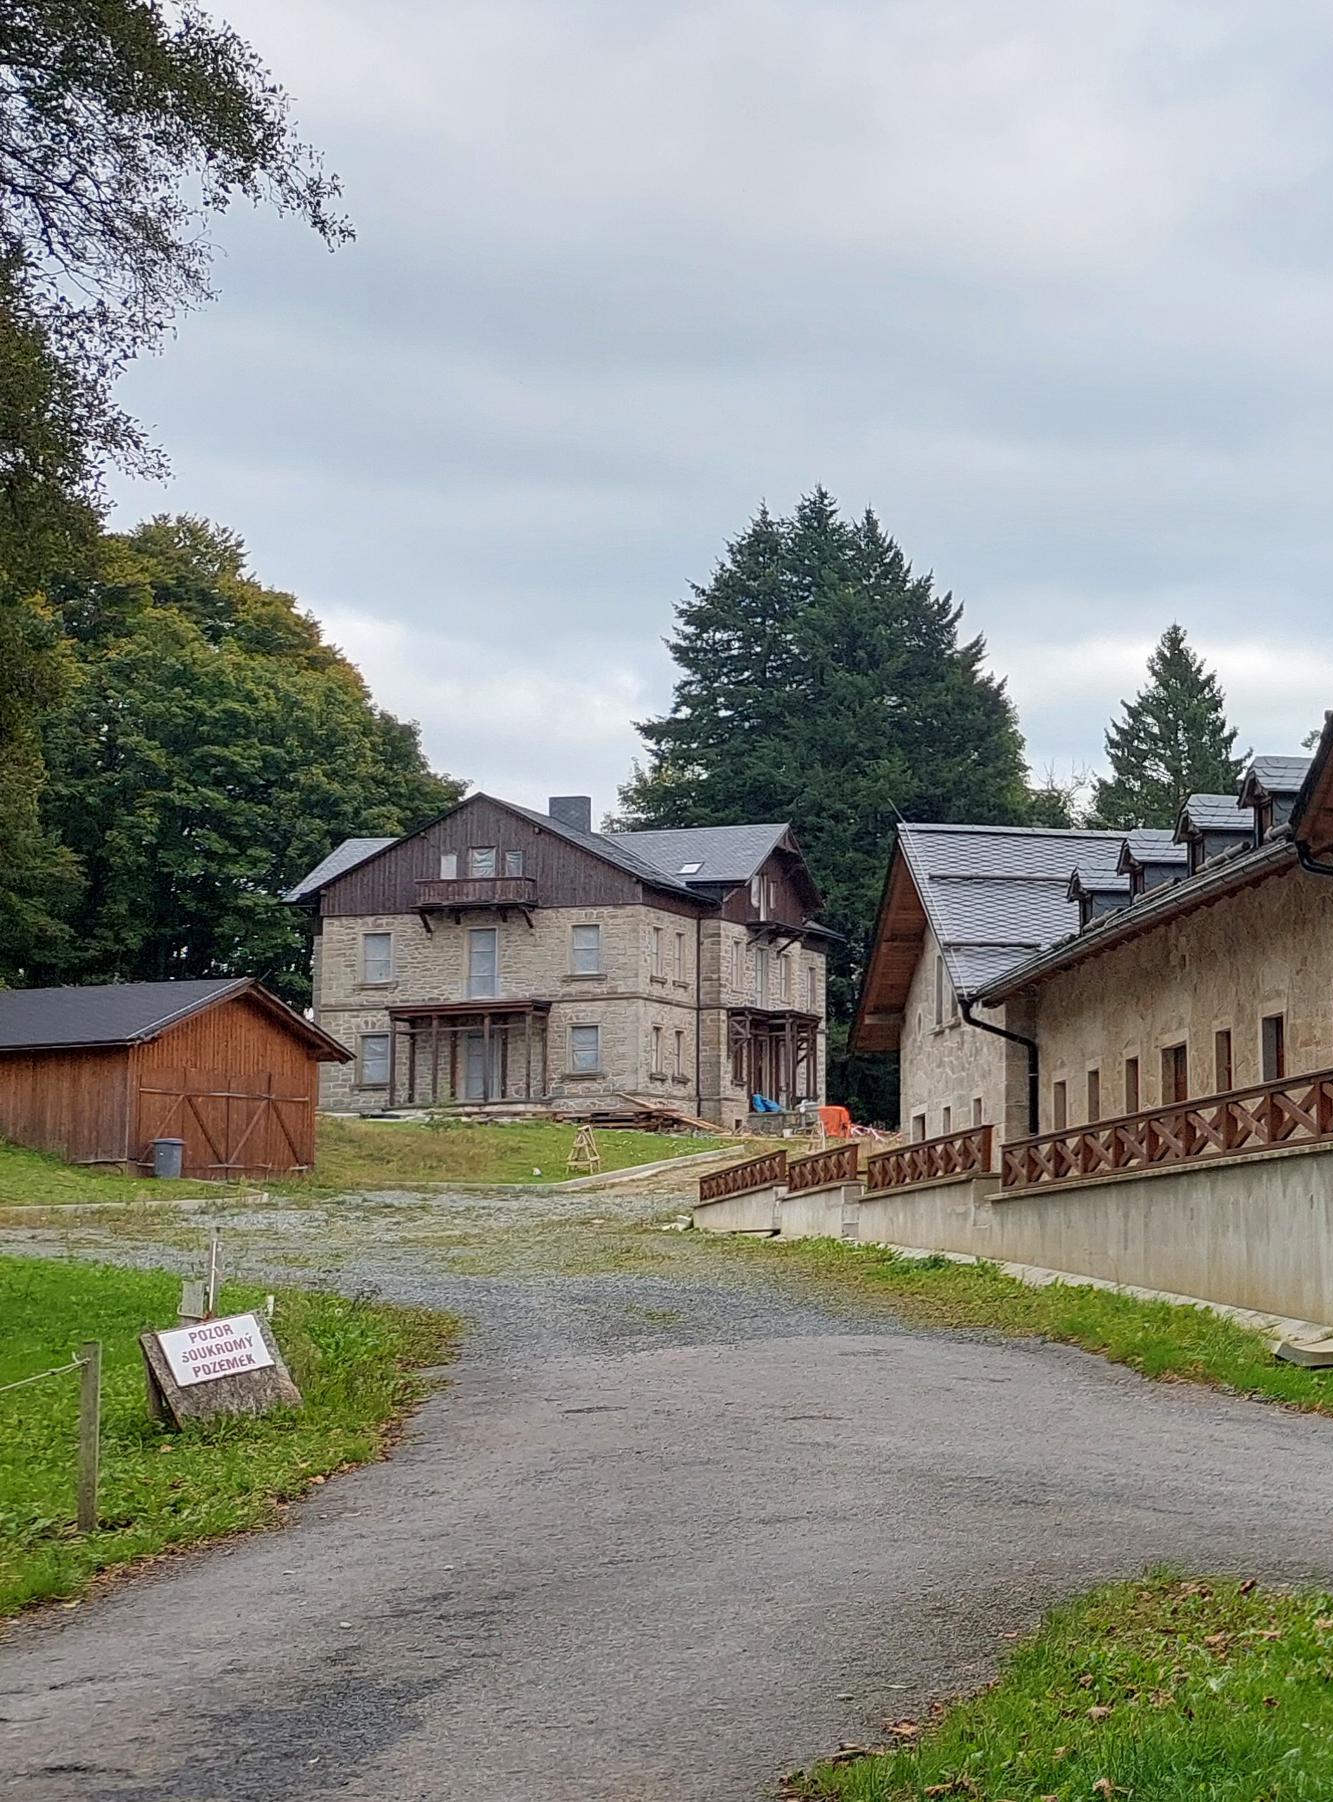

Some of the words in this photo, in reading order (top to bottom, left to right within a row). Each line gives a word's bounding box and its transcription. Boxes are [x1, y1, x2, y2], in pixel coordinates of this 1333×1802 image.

[188, 1323, 234, 1344] POZOR
[181, 1332, 254, 1364] SOUKROMÝ
[192, 1353, 256, 1378] POZEMEK
